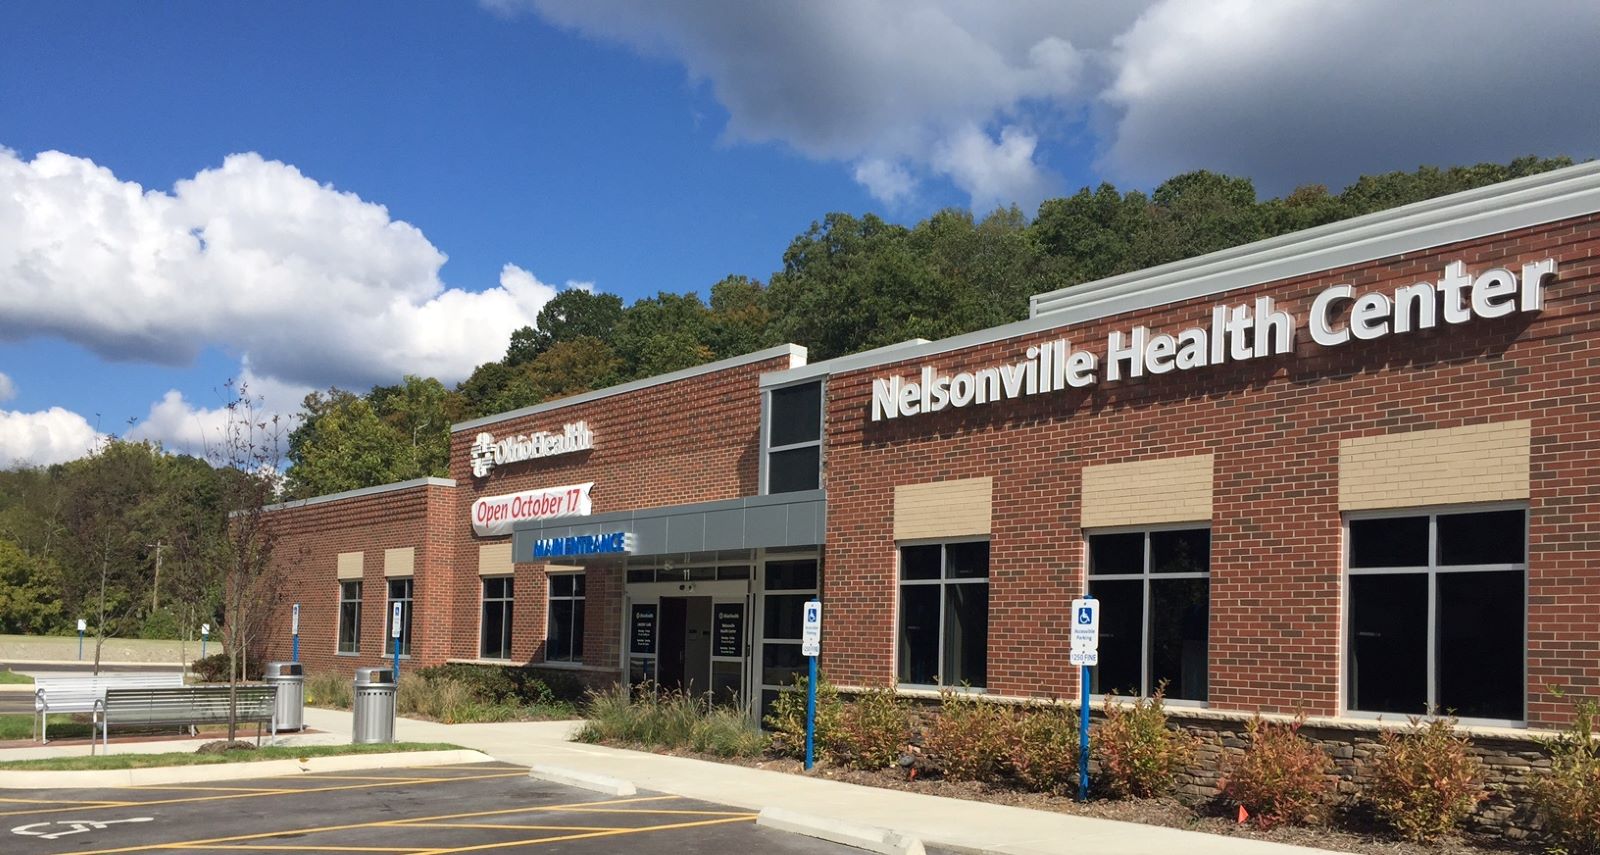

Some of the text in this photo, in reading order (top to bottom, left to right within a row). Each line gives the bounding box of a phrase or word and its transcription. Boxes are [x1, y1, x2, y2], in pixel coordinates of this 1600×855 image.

[871, 258, 1556, 421] Nelsonville Health Center
[495, 420, 594, 465] OhioHealth
[477, 488, 580, 528] Open October 17
[533, 532, 625, 557] MAIN ENTRANCE
[683, 569, 690, 580] 11
